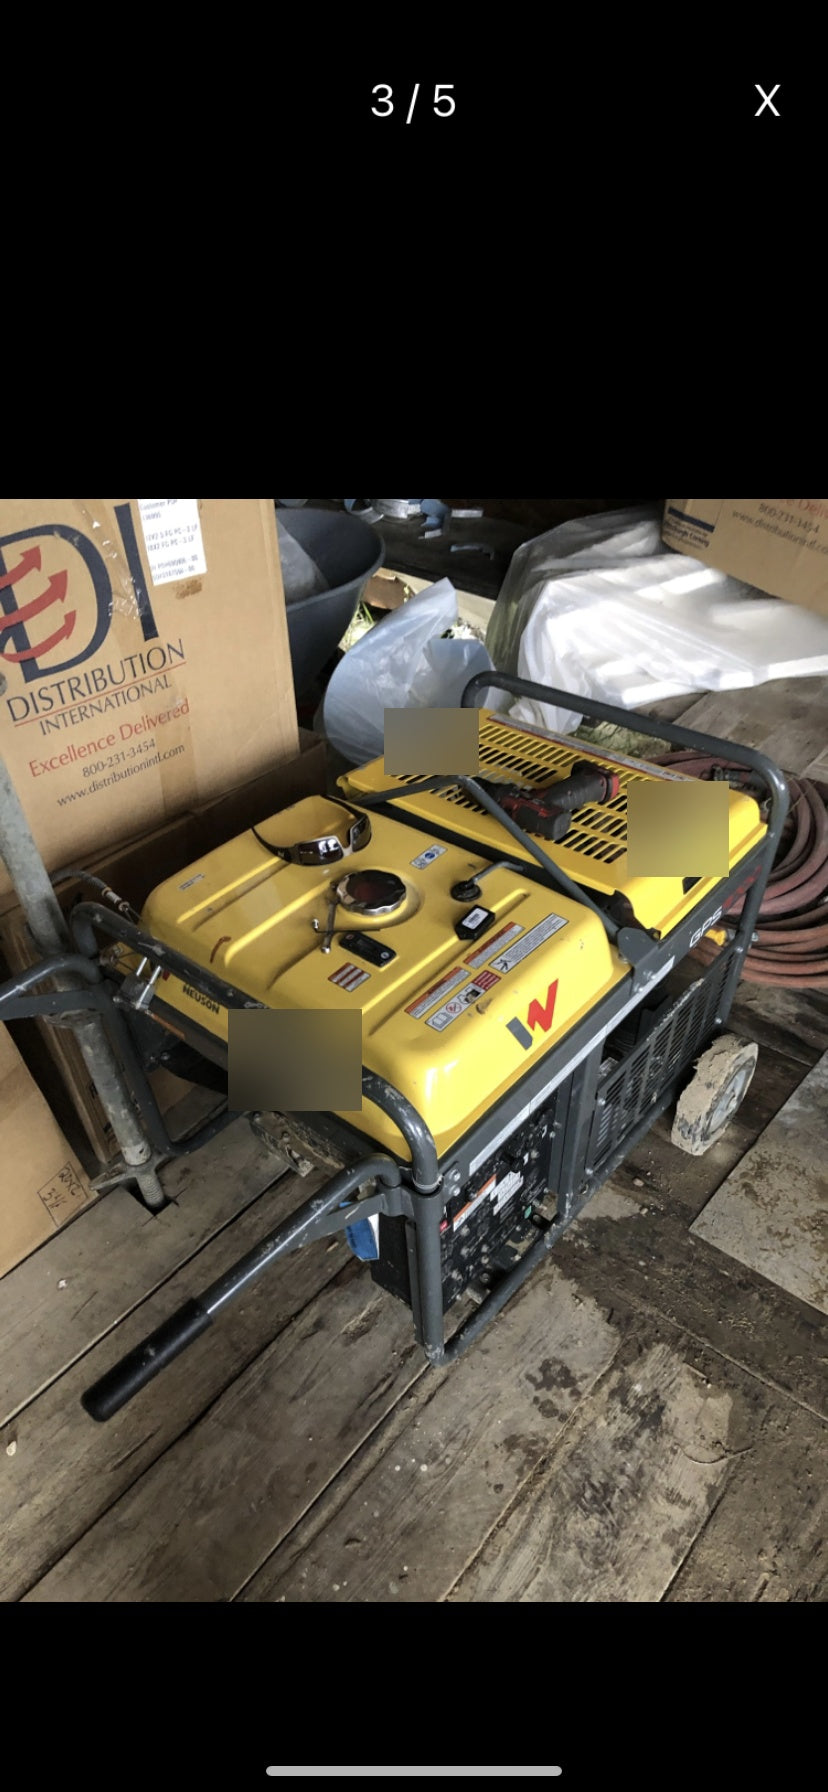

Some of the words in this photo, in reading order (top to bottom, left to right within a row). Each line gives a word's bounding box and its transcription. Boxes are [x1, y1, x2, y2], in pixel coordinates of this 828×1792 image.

[6, 638, 185, 722] DISTRIBUTION
[39, 674, 173, 736] INTERNATIONAL
[29, 734, 116, 778] Excellence
[119, 698, 190, 741] Delivered
[82, 738, 156, 778] 800-231-3454
[57, 744, 185, 806] www.distributionintl.com
[689, 905, 723, 948] GPS
[183, 983, 220, 1014] NEUSON
